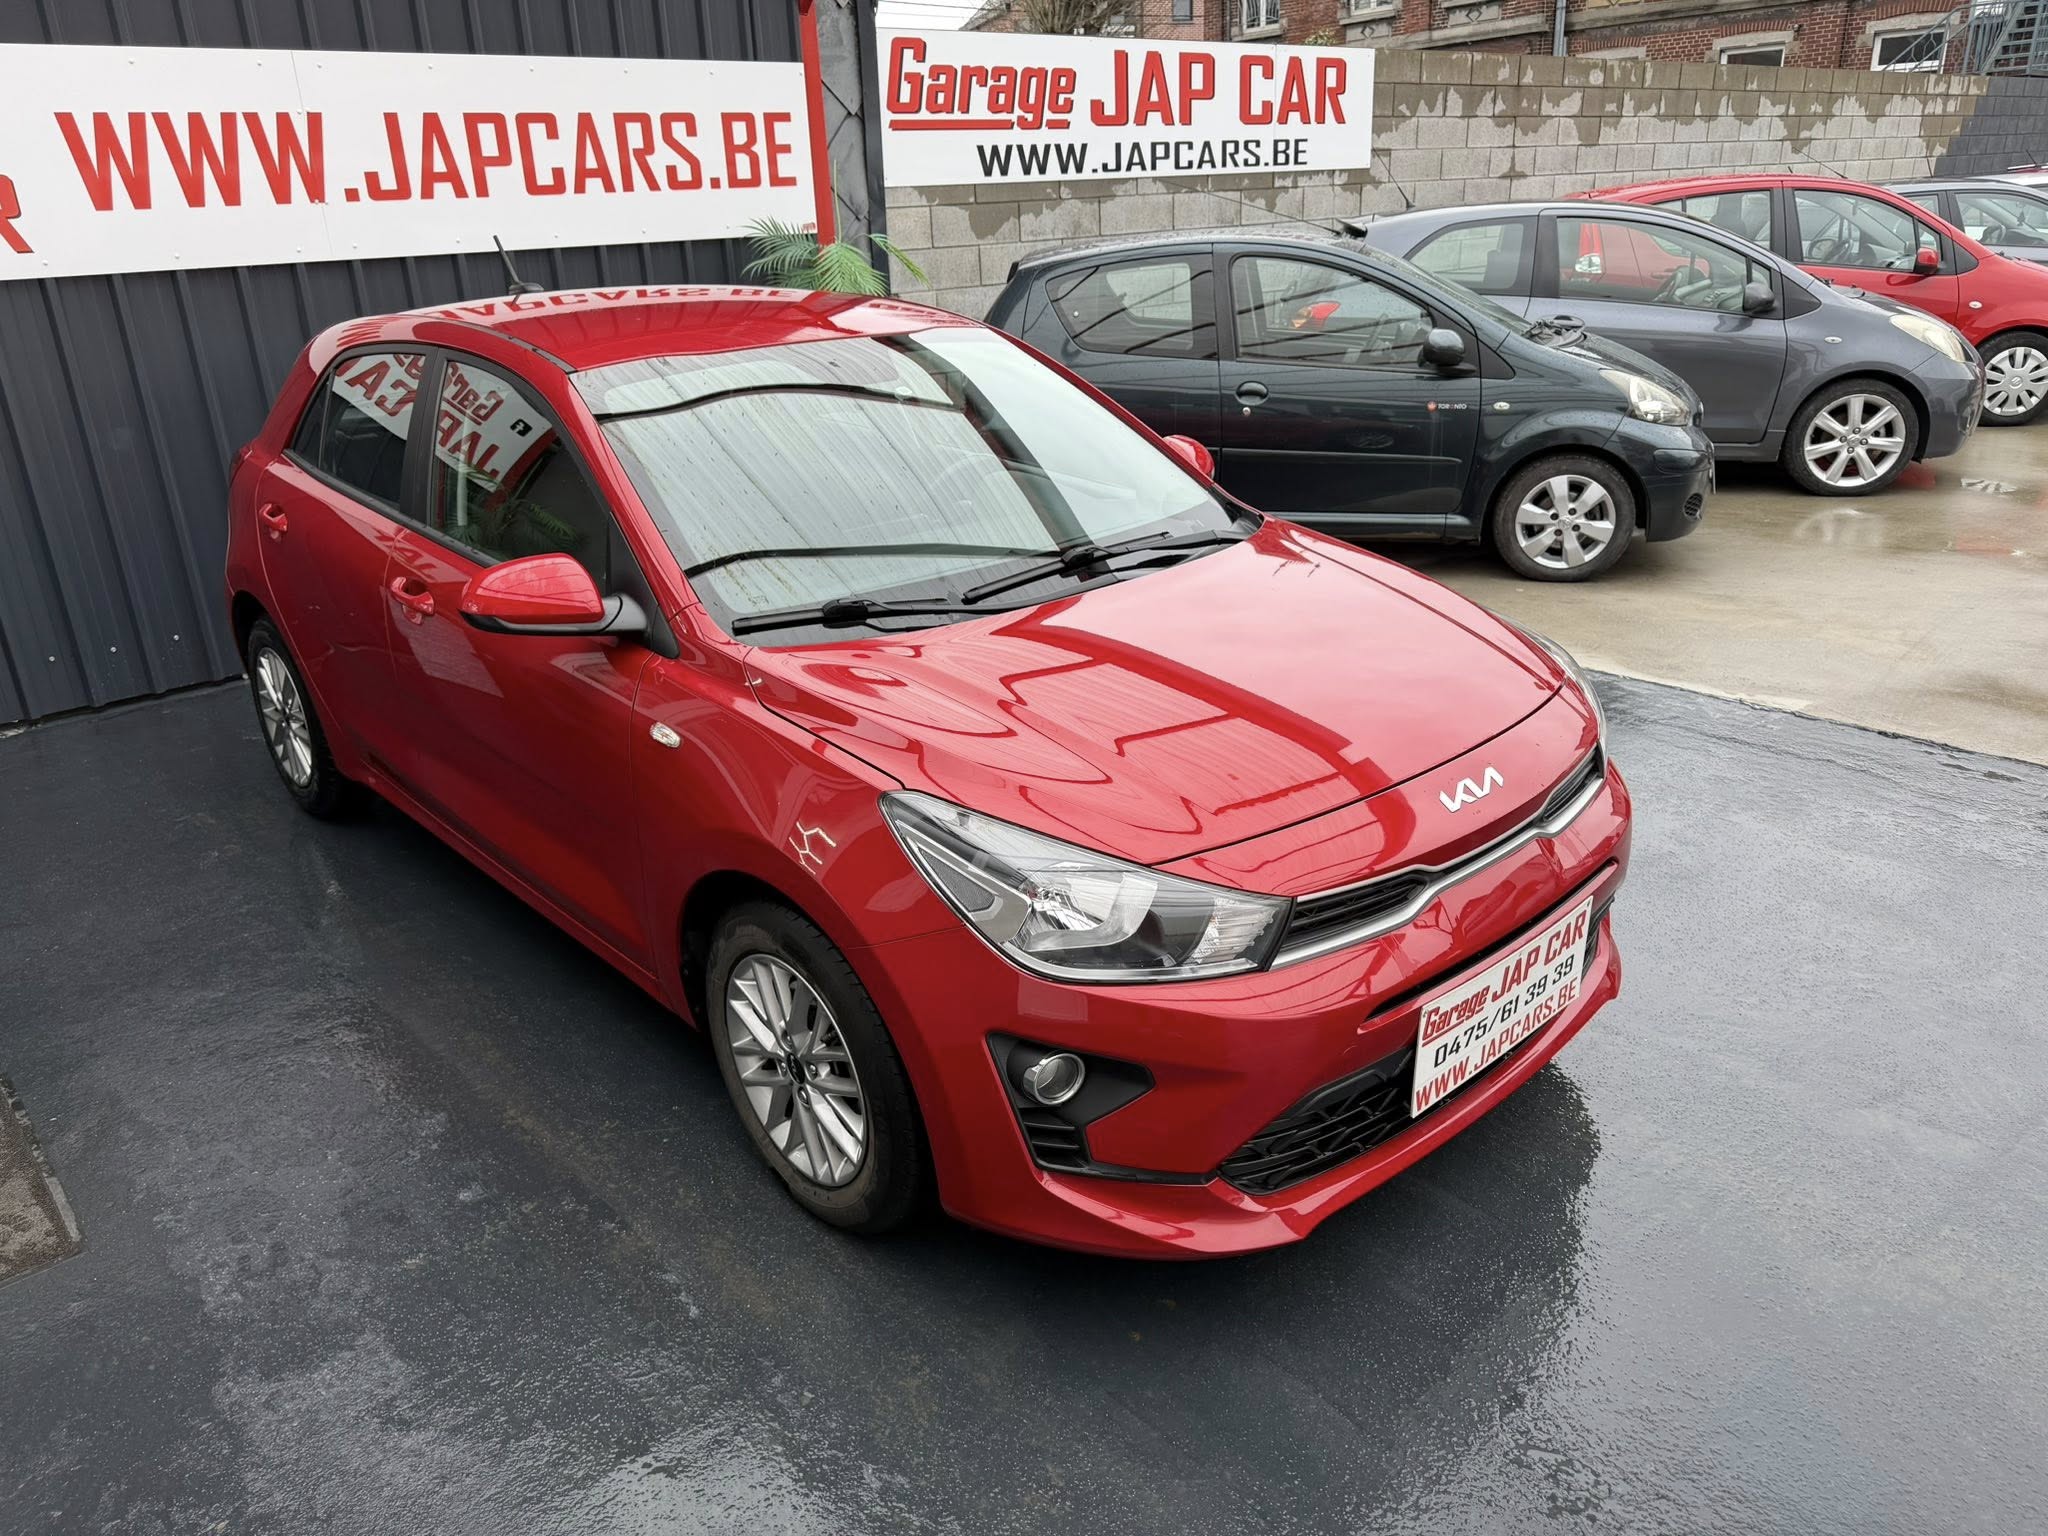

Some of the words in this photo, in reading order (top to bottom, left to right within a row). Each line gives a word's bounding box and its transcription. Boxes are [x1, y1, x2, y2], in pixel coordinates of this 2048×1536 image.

[887, 38, 1077, 131] Garage
[1091, 50, 1215, 126] JAP
[1239, 54, 1347, 125] CAR
[54, 112, 797, 211] WWW.JAPCARS.BE
[976, 138, 1308, 177] WWW.JAPCARS.BE
[1422, 985, 1490, 1041] Garage
[1491, 944, 1541, 1003] JAP
[1544, 909, 1587, 966] CAR
[1434, 995, 1519, 1068] 0475/61
[1524, 974, 1548, 1006] 39
[1552, 954, 1574, 985] 39
[1415, 976, 1578, 1112] WWW.JAPCARS.BE
